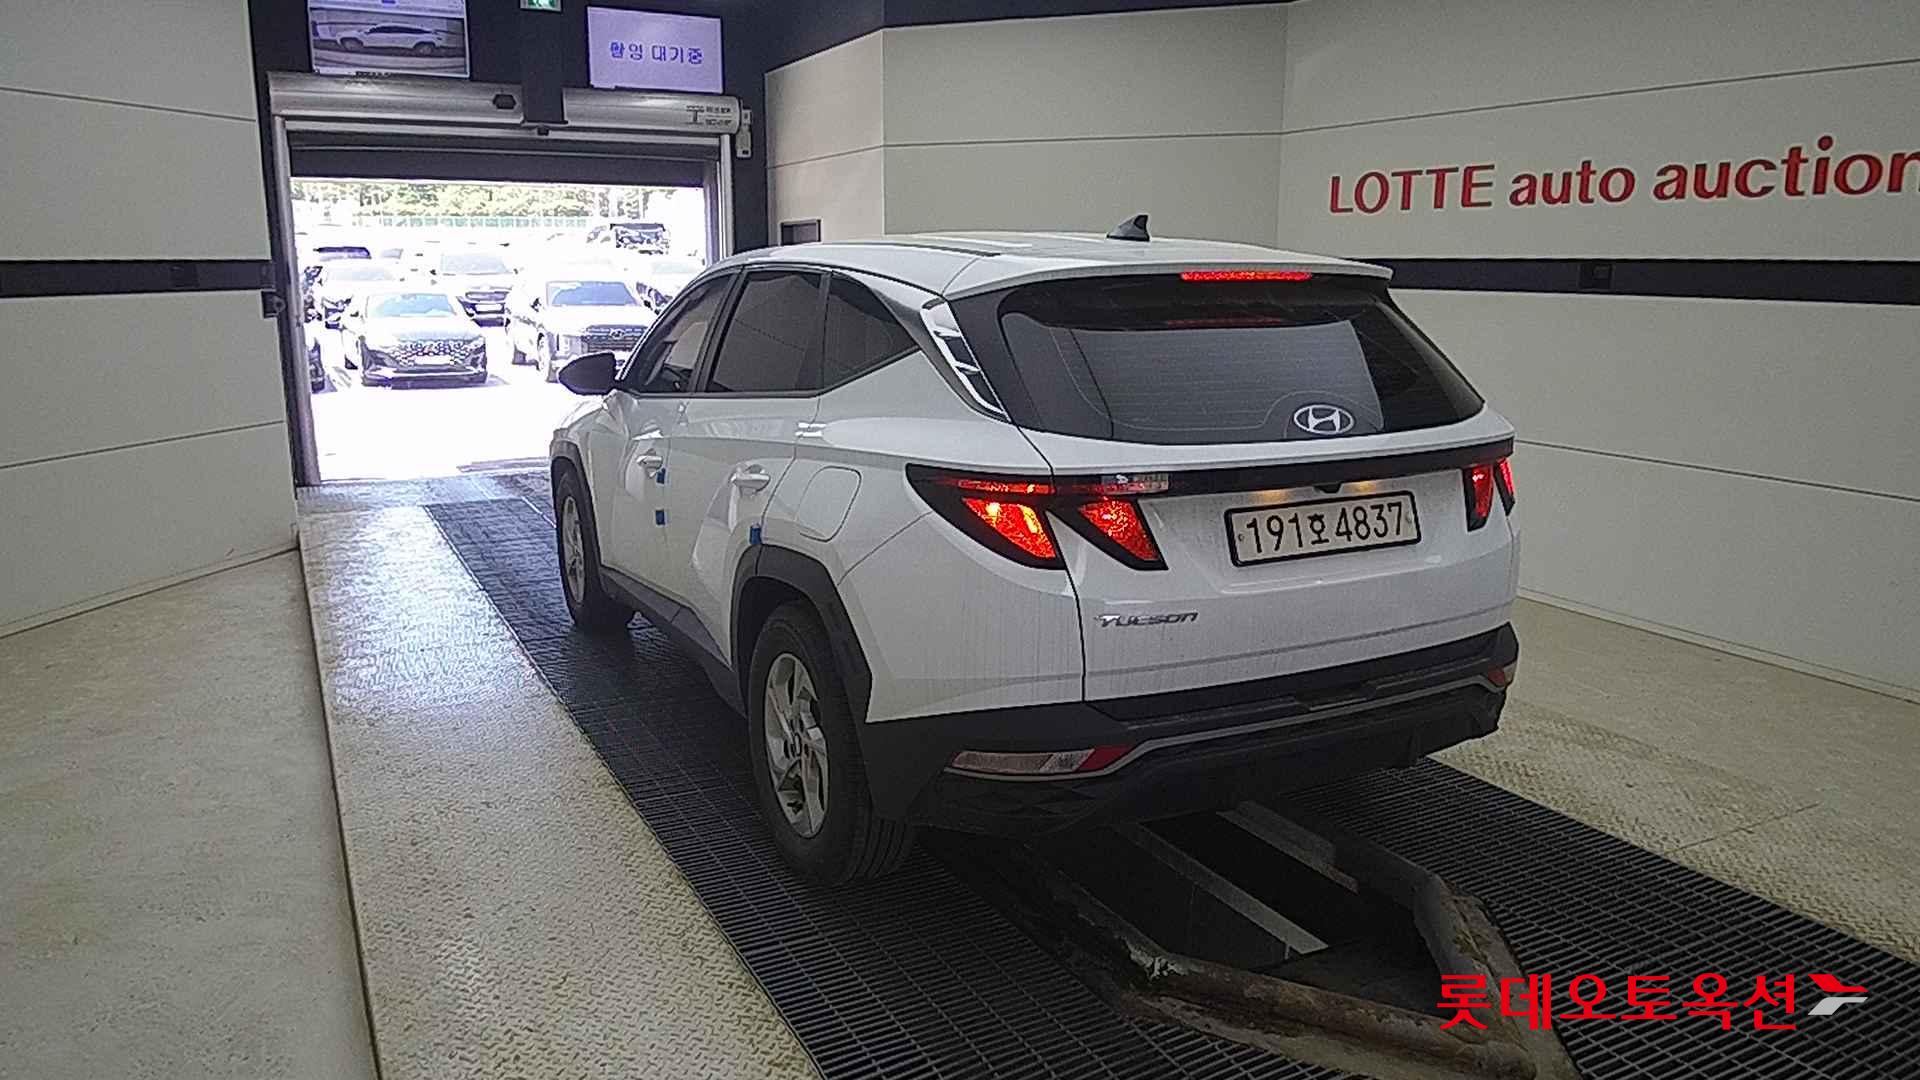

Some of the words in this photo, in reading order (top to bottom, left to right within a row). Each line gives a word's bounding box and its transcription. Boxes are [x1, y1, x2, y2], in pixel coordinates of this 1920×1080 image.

[652, 45, 703, 65] 대기중
[1329, 163, 1495, 214] LOTTE
[1508, 160, 1637, 206] auto
